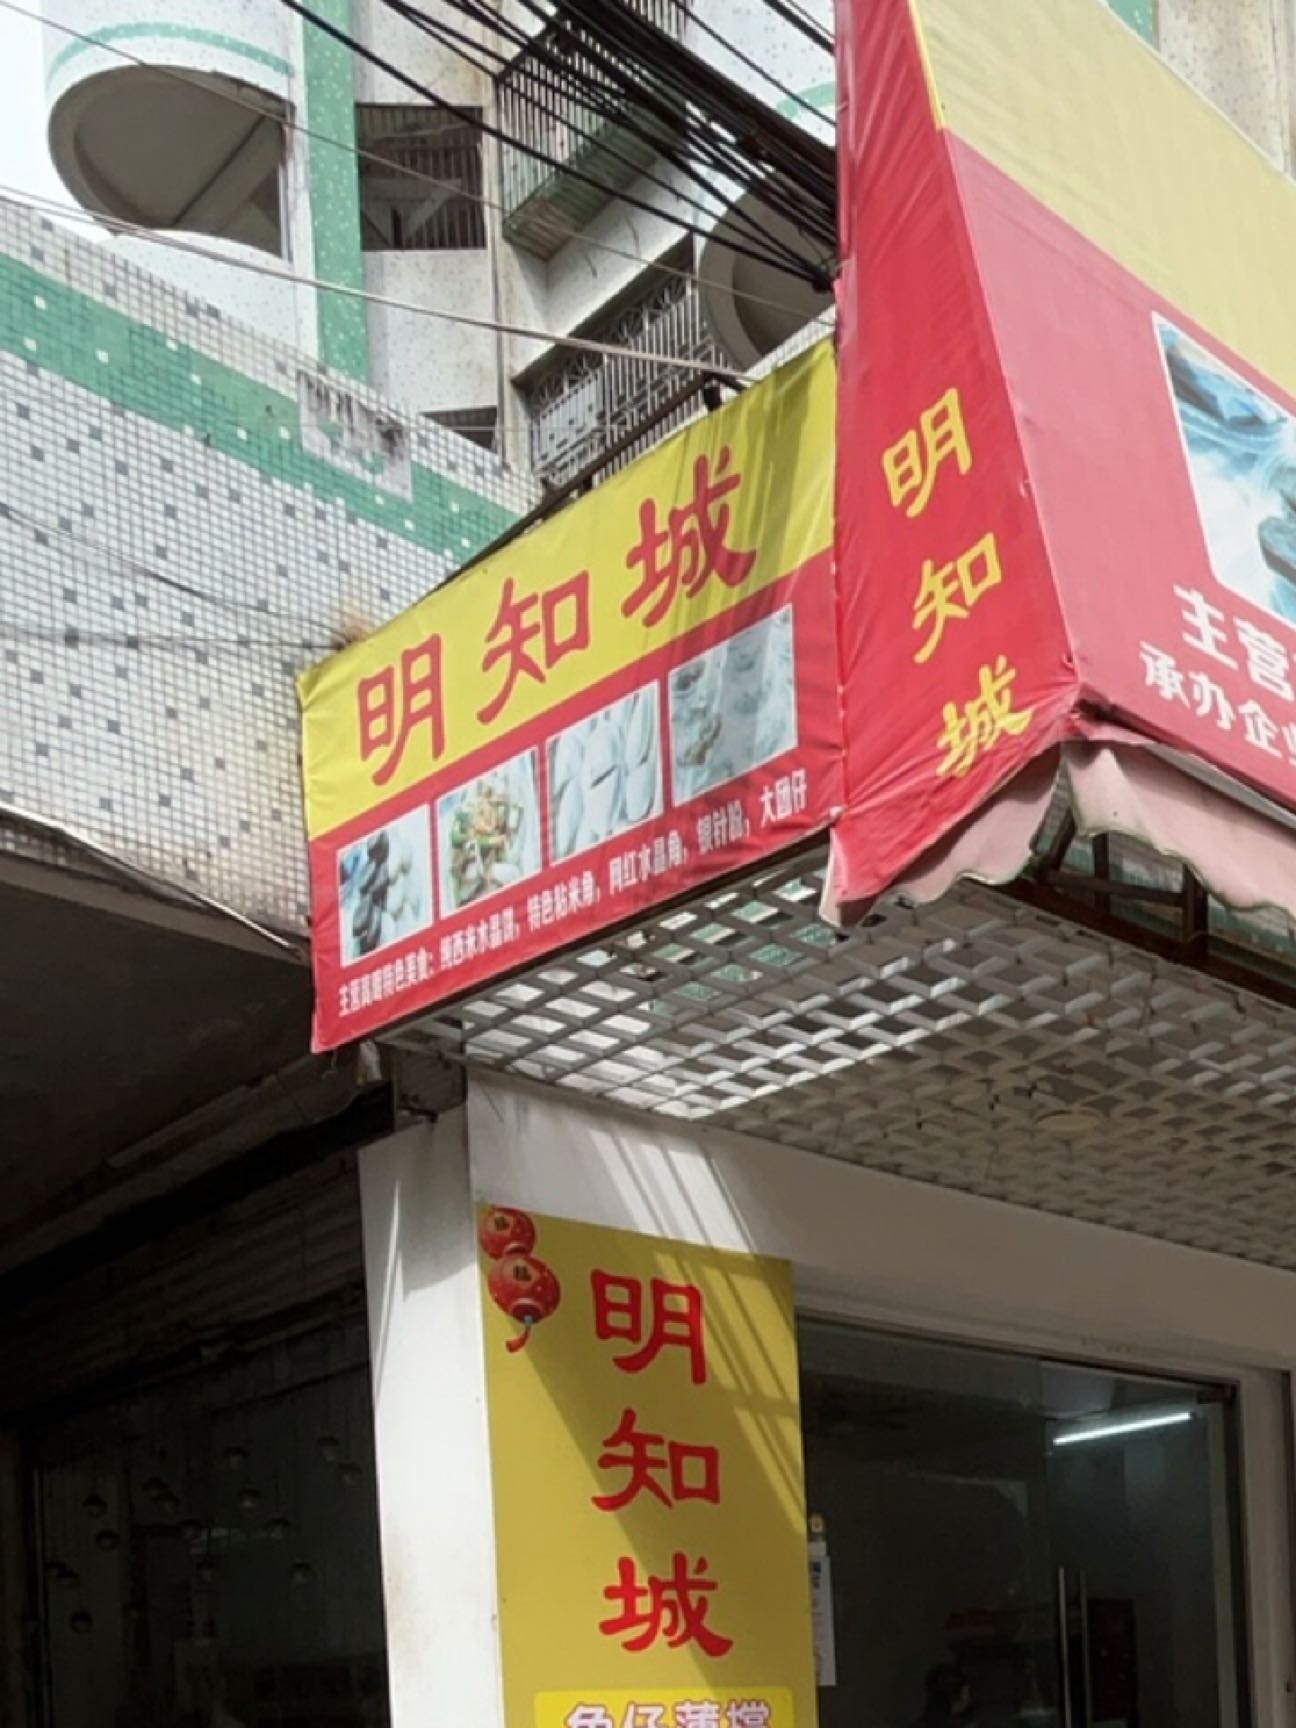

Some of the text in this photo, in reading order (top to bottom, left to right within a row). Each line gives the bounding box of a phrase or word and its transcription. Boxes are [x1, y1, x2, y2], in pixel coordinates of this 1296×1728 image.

[356, 445, 757, 786] 明知城
[882, 388, 1033, 778] 明知城
[590, 1267, 734, 1657] 明知城
